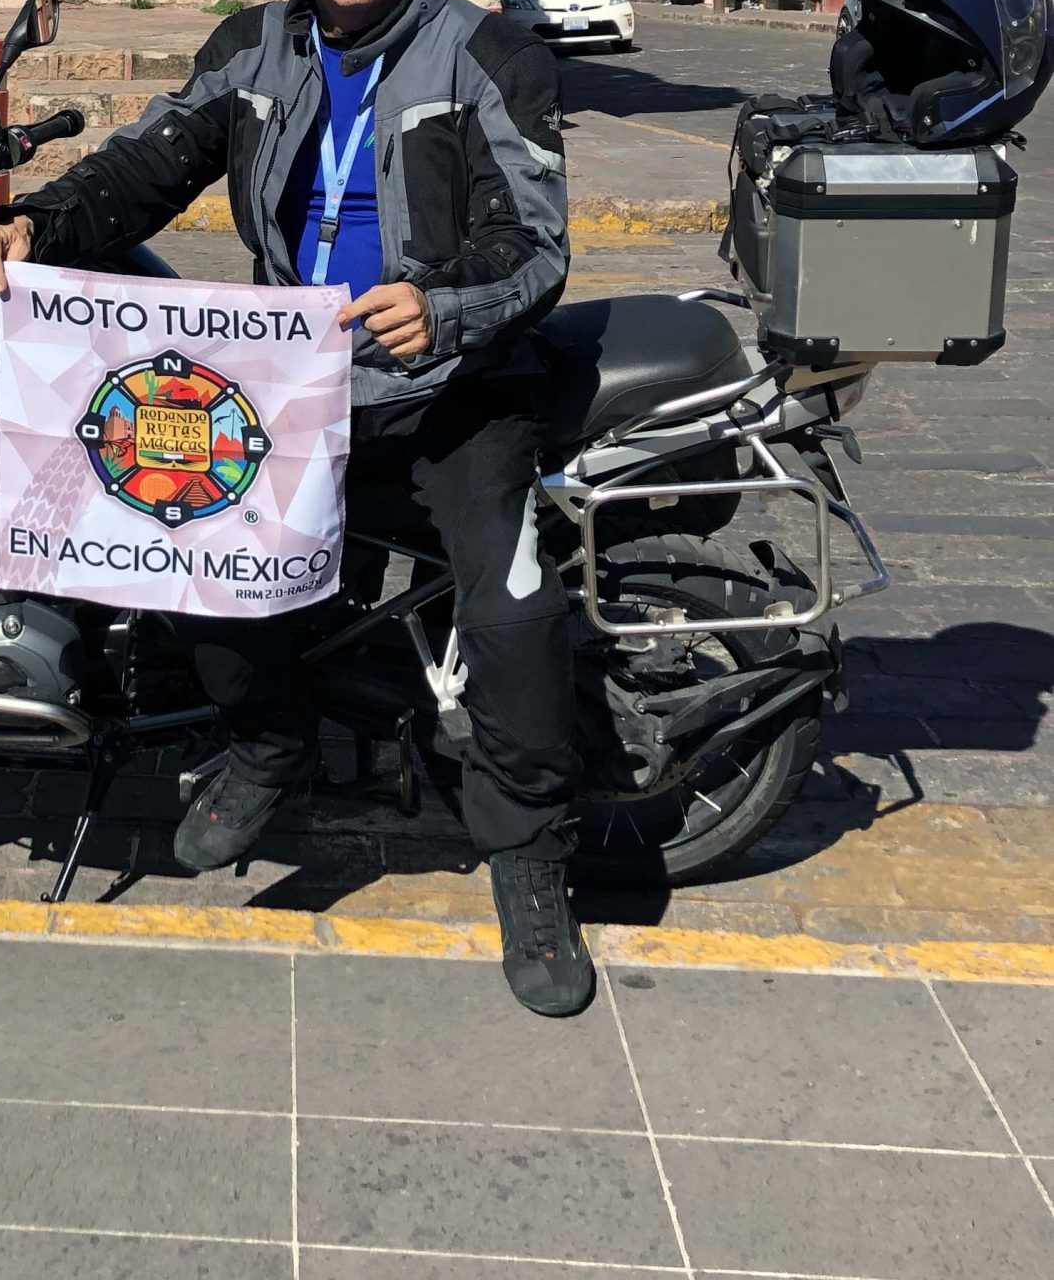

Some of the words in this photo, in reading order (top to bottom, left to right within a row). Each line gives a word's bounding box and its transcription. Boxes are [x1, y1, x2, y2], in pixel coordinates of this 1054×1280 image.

[31, 290, 148, 332] MOTO
[159, 304, 312, 341] TURISTA
[163, 358, 182, 371] N
[82, 424, 99, 438] O
[249, 437, 264, 450] E
[165, 507, 182, 520] S
[10, 527, 48, 558] EN
[58, 538, 194, 576] ACCIÓN
[204, 547, 331, 582] MÉXICO
